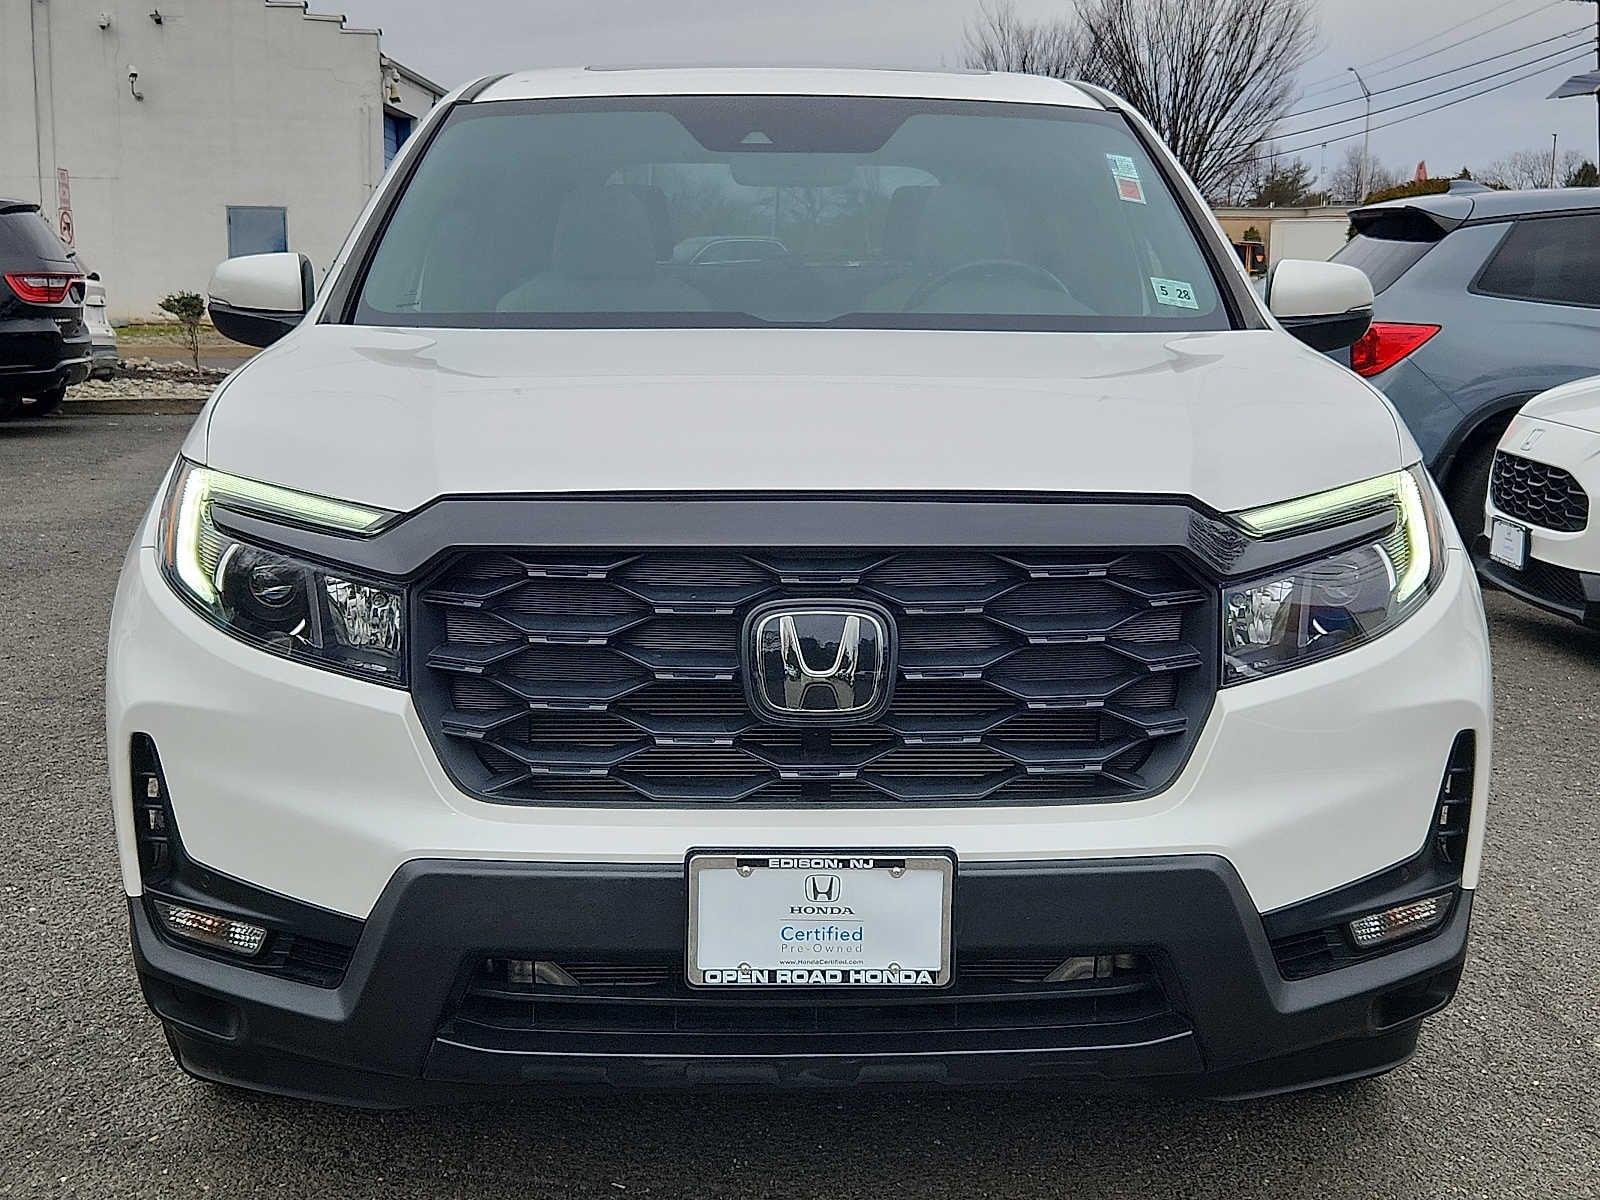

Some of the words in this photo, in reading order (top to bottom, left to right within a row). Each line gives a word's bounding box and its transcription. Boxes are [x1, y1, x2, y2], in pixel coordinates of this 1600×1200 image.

[1160, 286, 1168, 295] 5
[1176, 289, 1191, 300] 28
[768, 858, 843, 869] EDISON,
[850, 859, 874, 869] NJ
[790, 906, 855, 915] HONDA
[781, 926, 863, 941] Certified
[781, 943, 862, 953] Pre-Owned
[705, 970, 769, 983] OPEN
[776, 970, 842, 984] ROAD
[849, 971, 933, 984] HONDA
